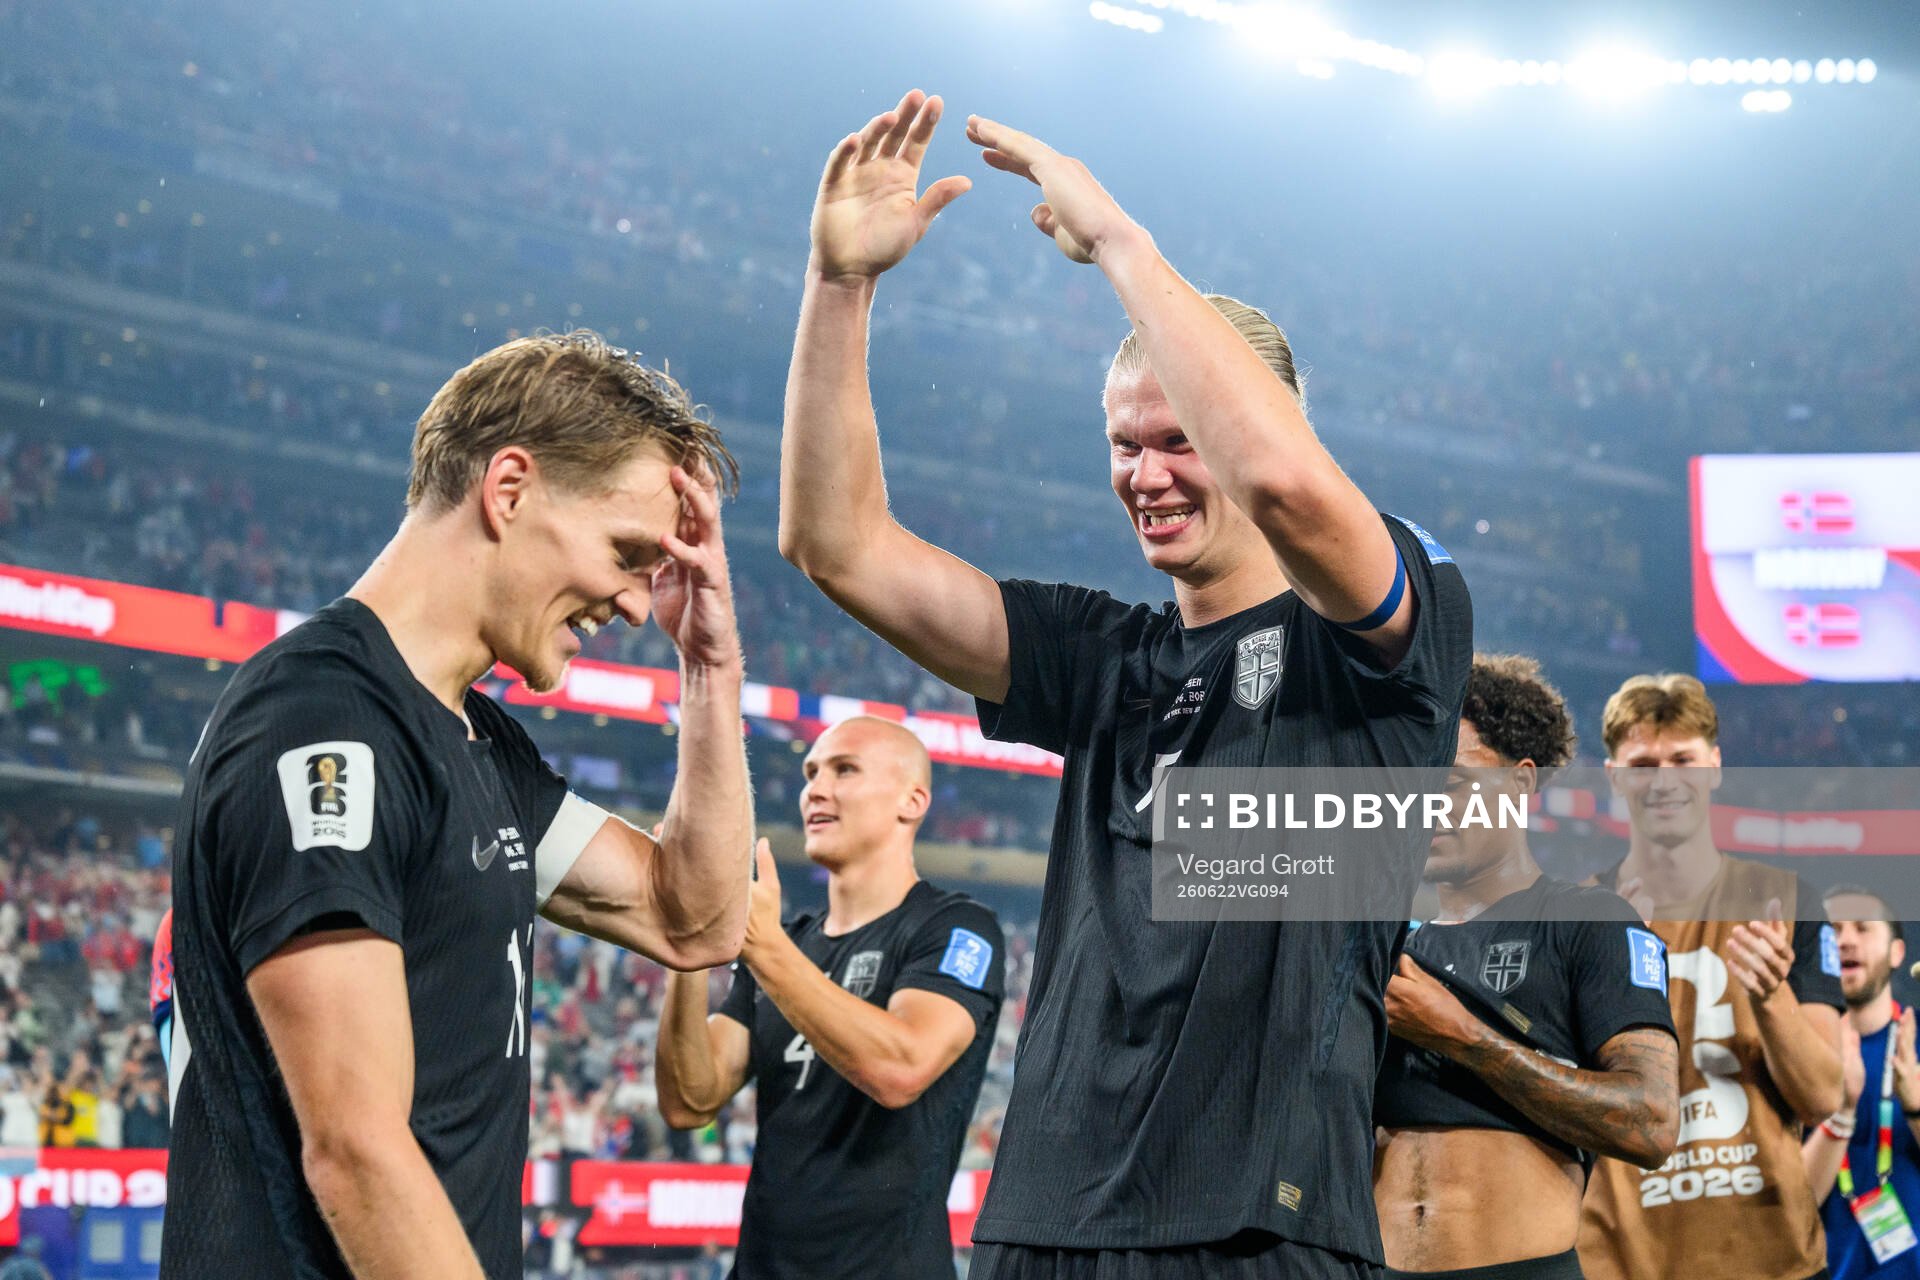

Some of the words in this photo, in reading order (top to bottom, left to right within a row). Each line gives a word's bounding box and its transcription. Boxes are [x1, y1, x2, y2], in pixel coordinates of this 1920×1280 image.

[784, 1032, 815, 1090] 4
[1680, 1101, 1718, 1124] IFA
[1715, 1143, 1759, 1166] CUP
[1640, 1165, 1765, 1208] 2026
